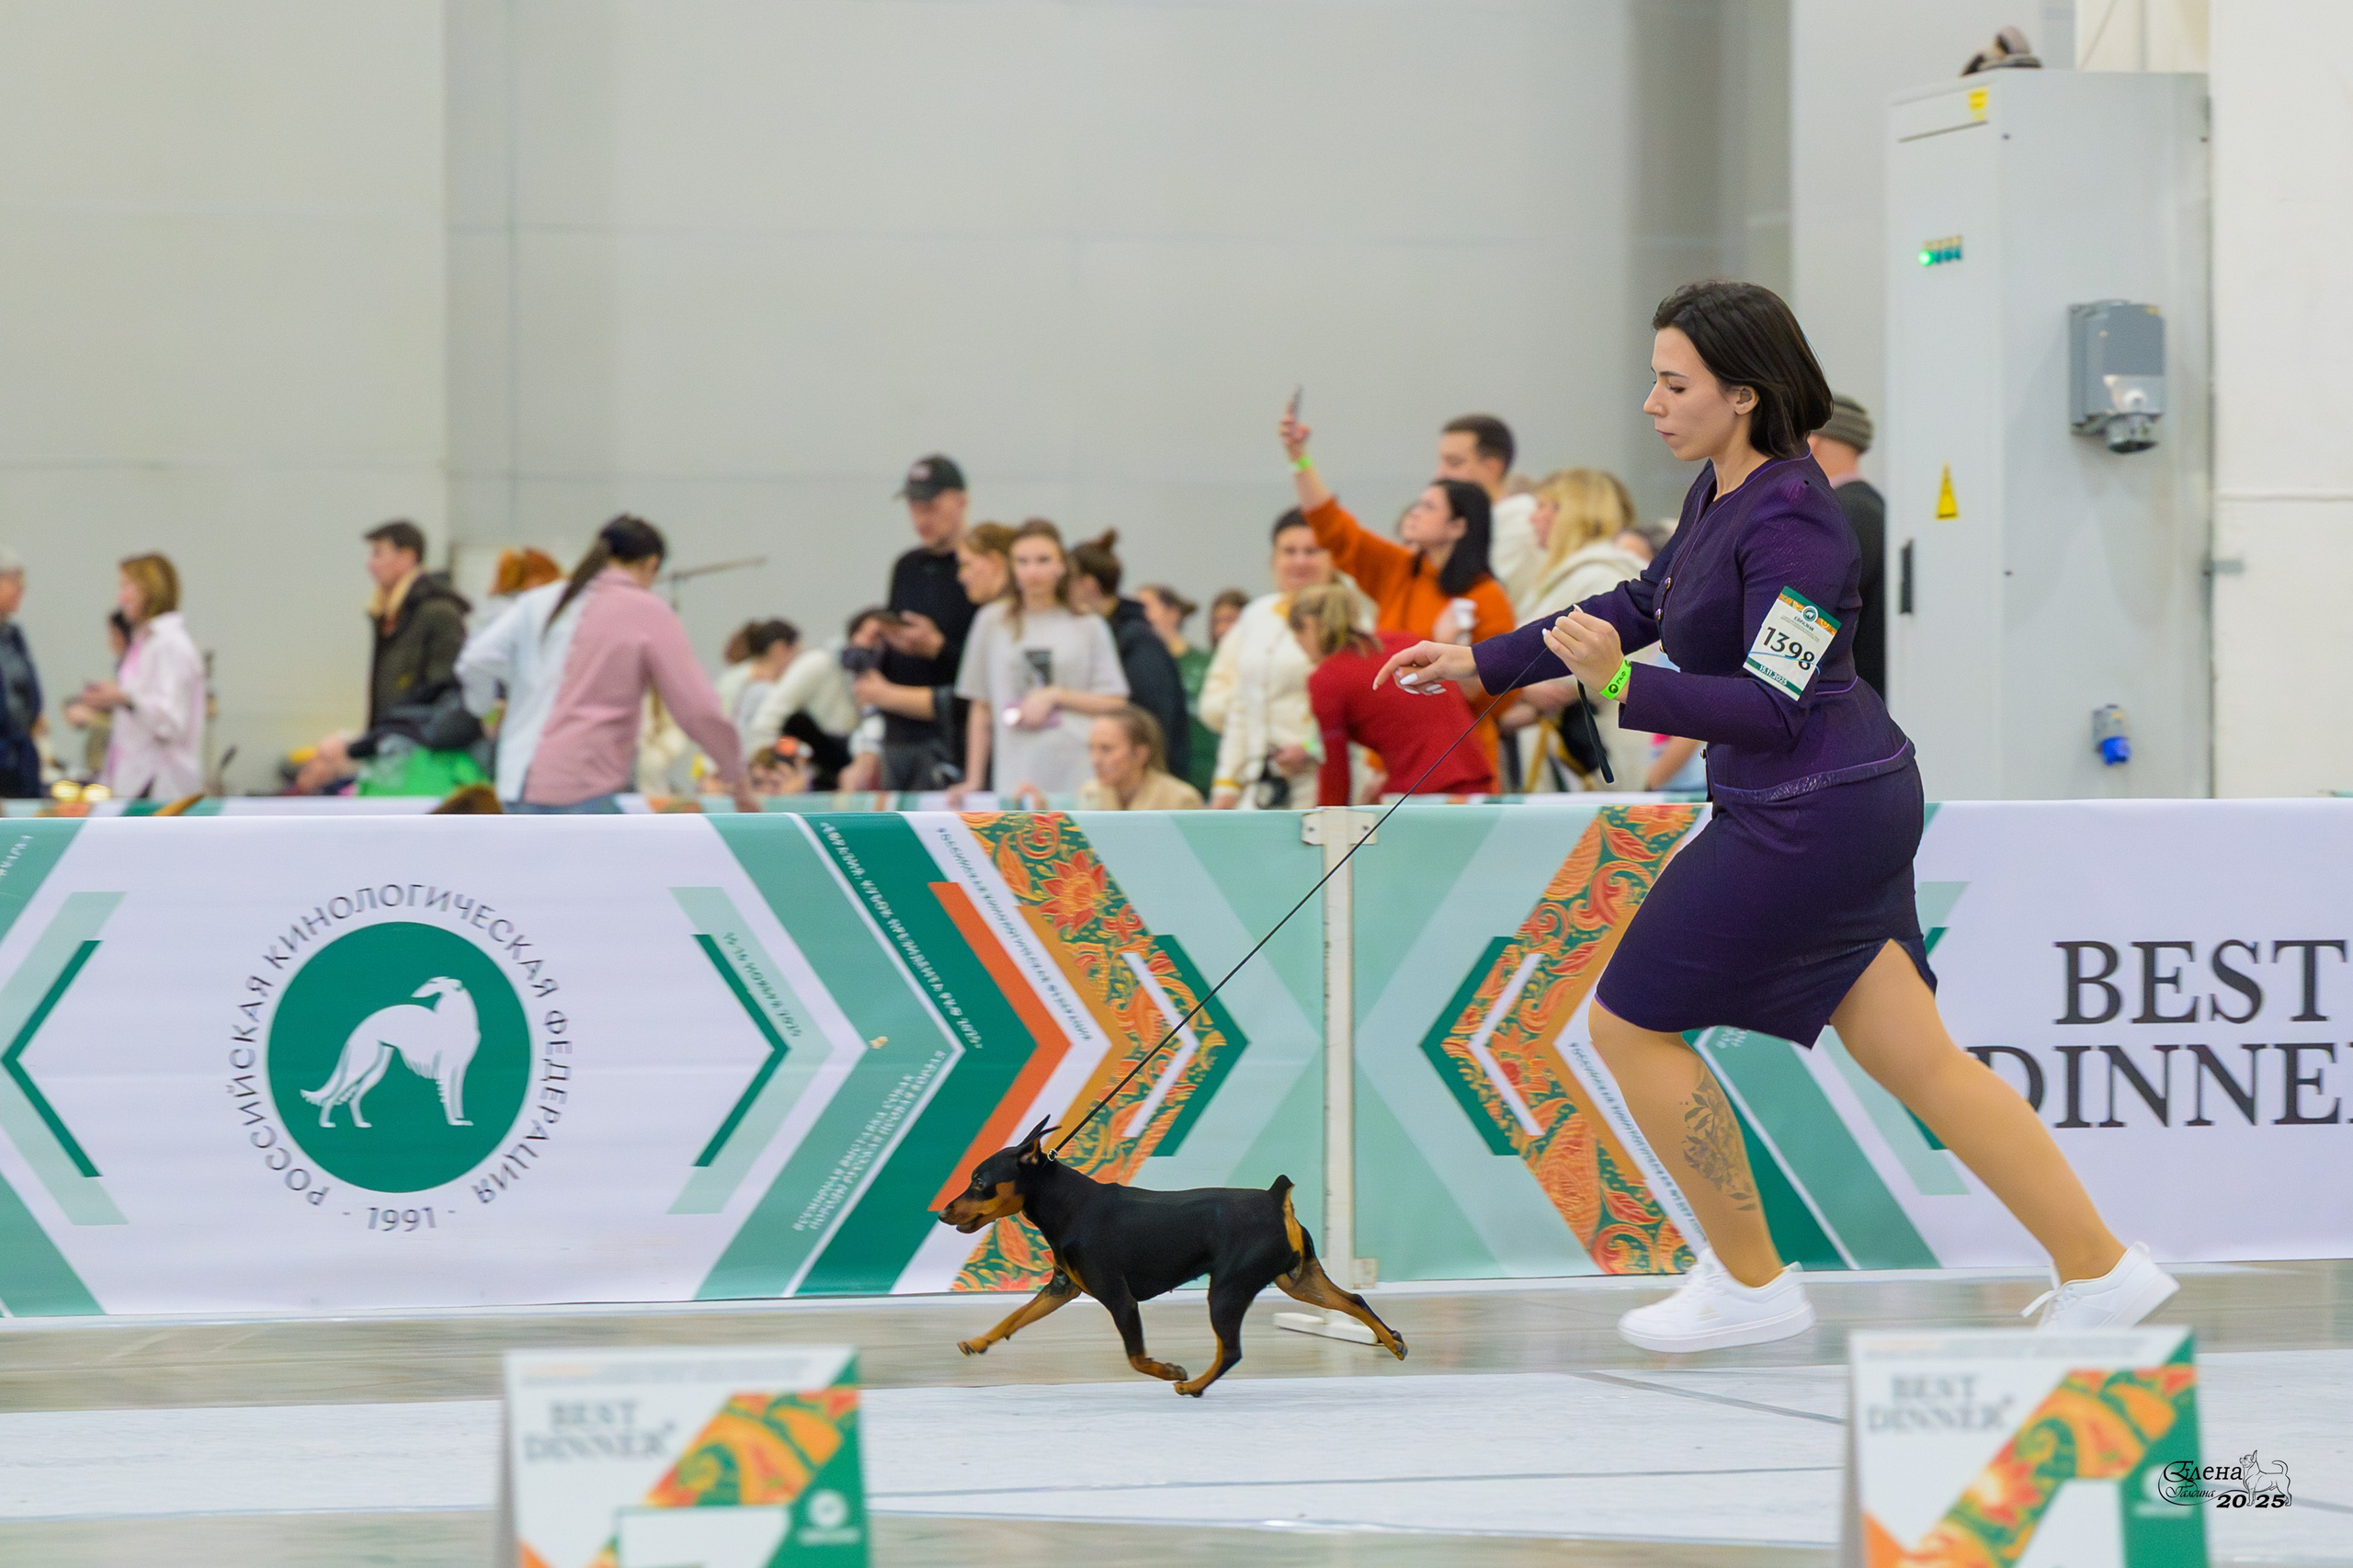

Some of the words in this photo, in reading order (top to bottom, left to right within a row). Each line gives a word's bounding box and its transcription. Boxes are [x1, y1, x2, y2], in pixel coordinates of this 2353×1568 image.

[1763, 626, 1815, 671] 1398
[937, 827, 988, 893] РОССИЙСКАЯ
[264, 883, 559, 998] КИНОЛОГИЧЕСКАЯ
[859, 880, 894, 918] КУБОК
[885, 918, 944, 992] ПРЕЗИДЕНТА
[938, 992, 962, 1017] РКФ
[744, 962, 783, 1008] НОЯБРЯ
[776, 1010, 802, 1037] 2025
[2052, 938, 2348, 1025] BEST
[226, 973, 330, 1207] РОССИЙСКАЯ
[471, 1009, 573, 1205] ФЕДЕРАЦИЯ
[1964, 1040, 2353, 1129] DINNE
[368, 1205, 438, 1233] 1991
[550, 1398, 638, 1426] BEST
[1891, 1372, 1978, 1399] BEST
